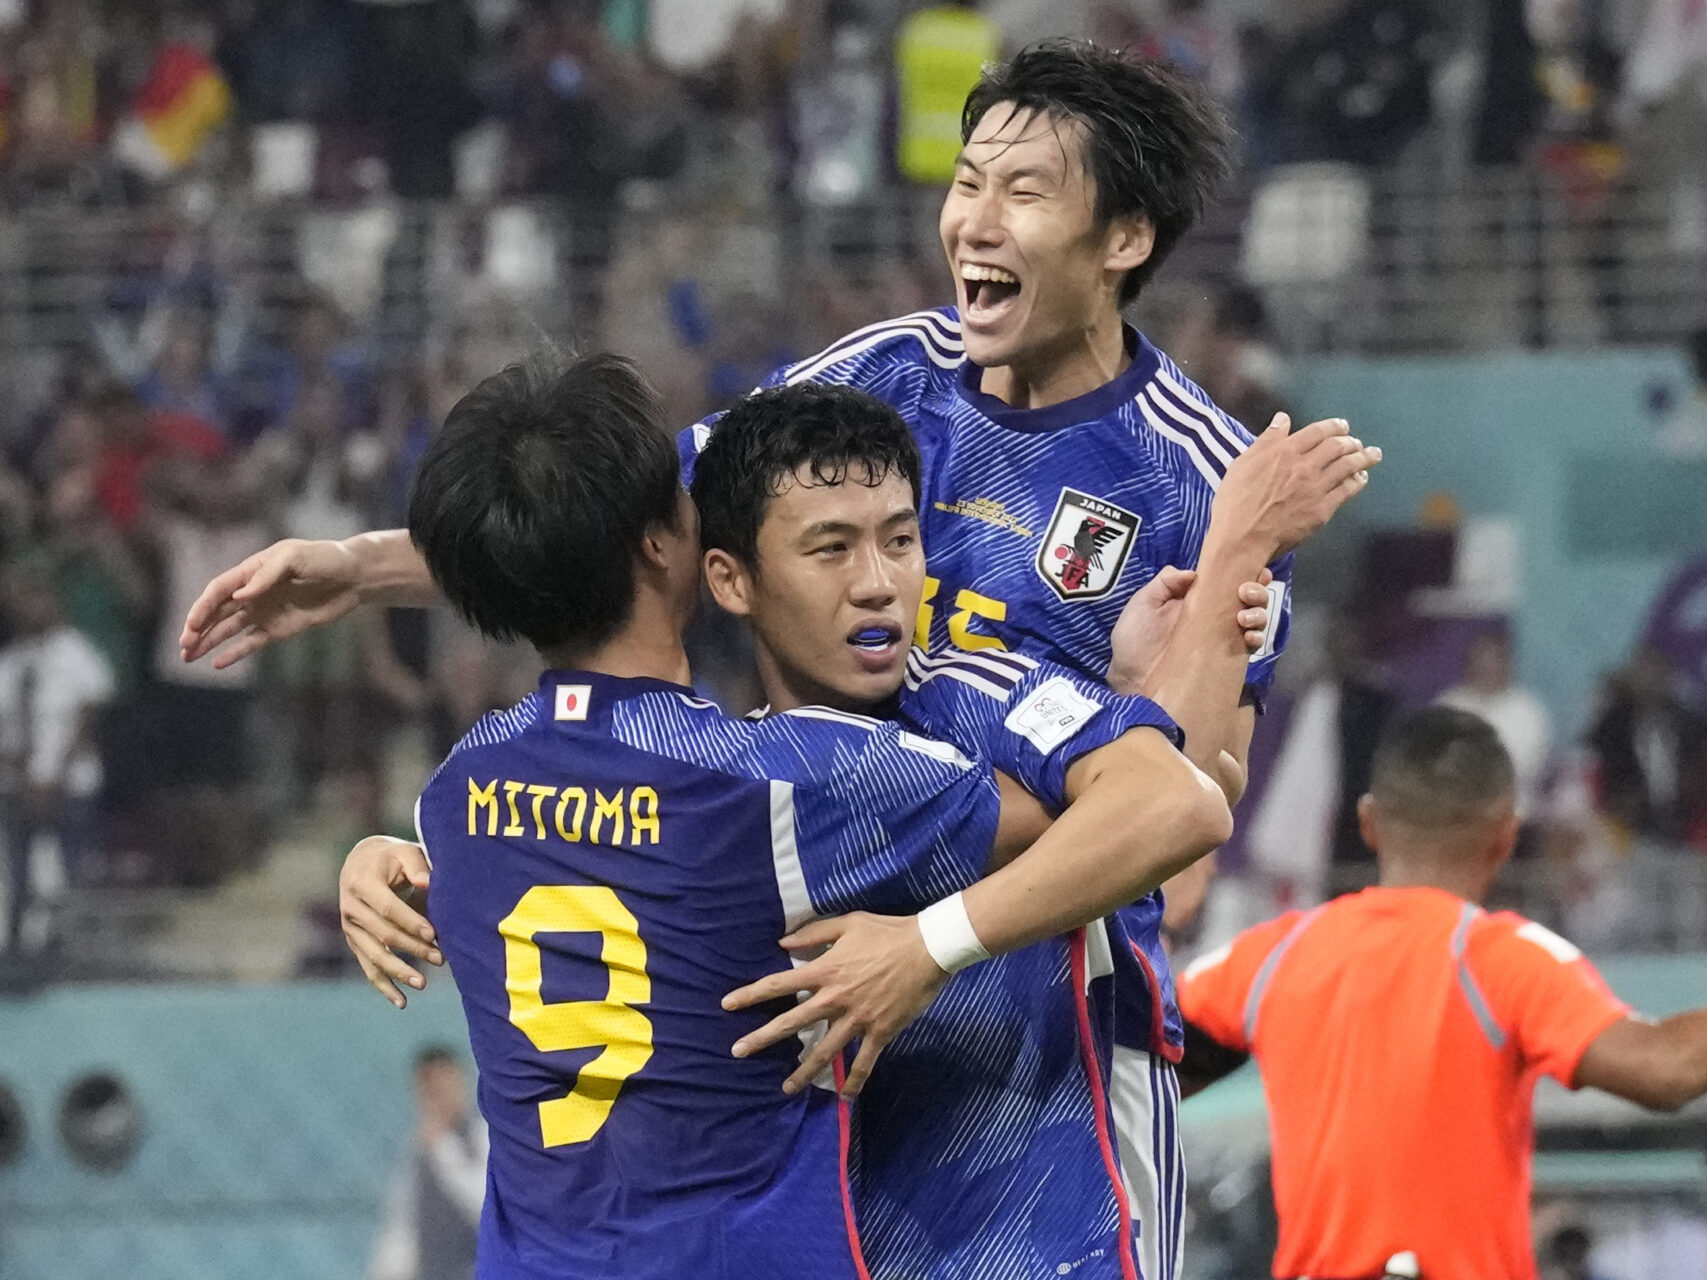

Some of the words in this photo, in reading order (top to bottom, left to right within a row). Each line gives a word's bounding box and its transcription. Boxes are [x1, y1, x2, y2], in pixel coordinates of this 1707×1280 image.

[1080, 499, 1121, 520] JAPAN
[1055, 563, 1088, 588] JFA
[468, 776, 660, 846] MITOMA
[498, 886, 654, 1149] 9
